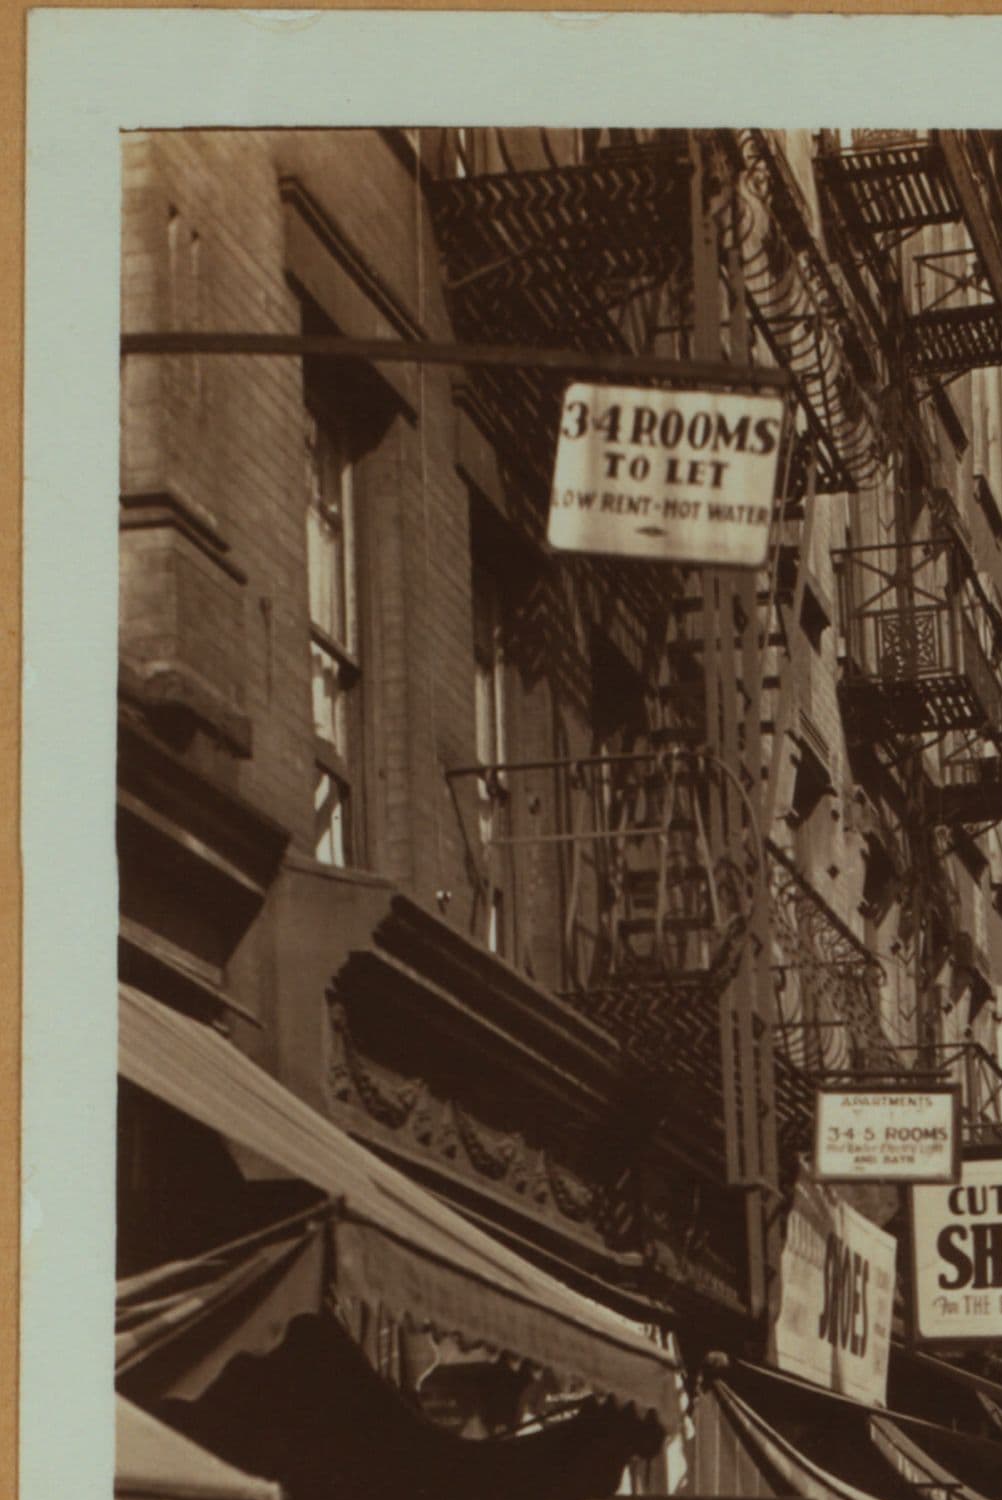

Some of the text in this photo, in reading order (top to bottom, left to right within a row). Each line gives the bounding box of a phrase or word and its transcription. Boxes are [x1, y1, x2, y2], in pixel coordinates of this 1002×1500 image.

[629, 406, 780, 456] ROOMS
[604, 452, 729, 490] TO LET
[708, 503, 769, 527] WATER
[885, 1127, 948, 1142] ROOMS
[963, 1295, 990, 1315] THE
